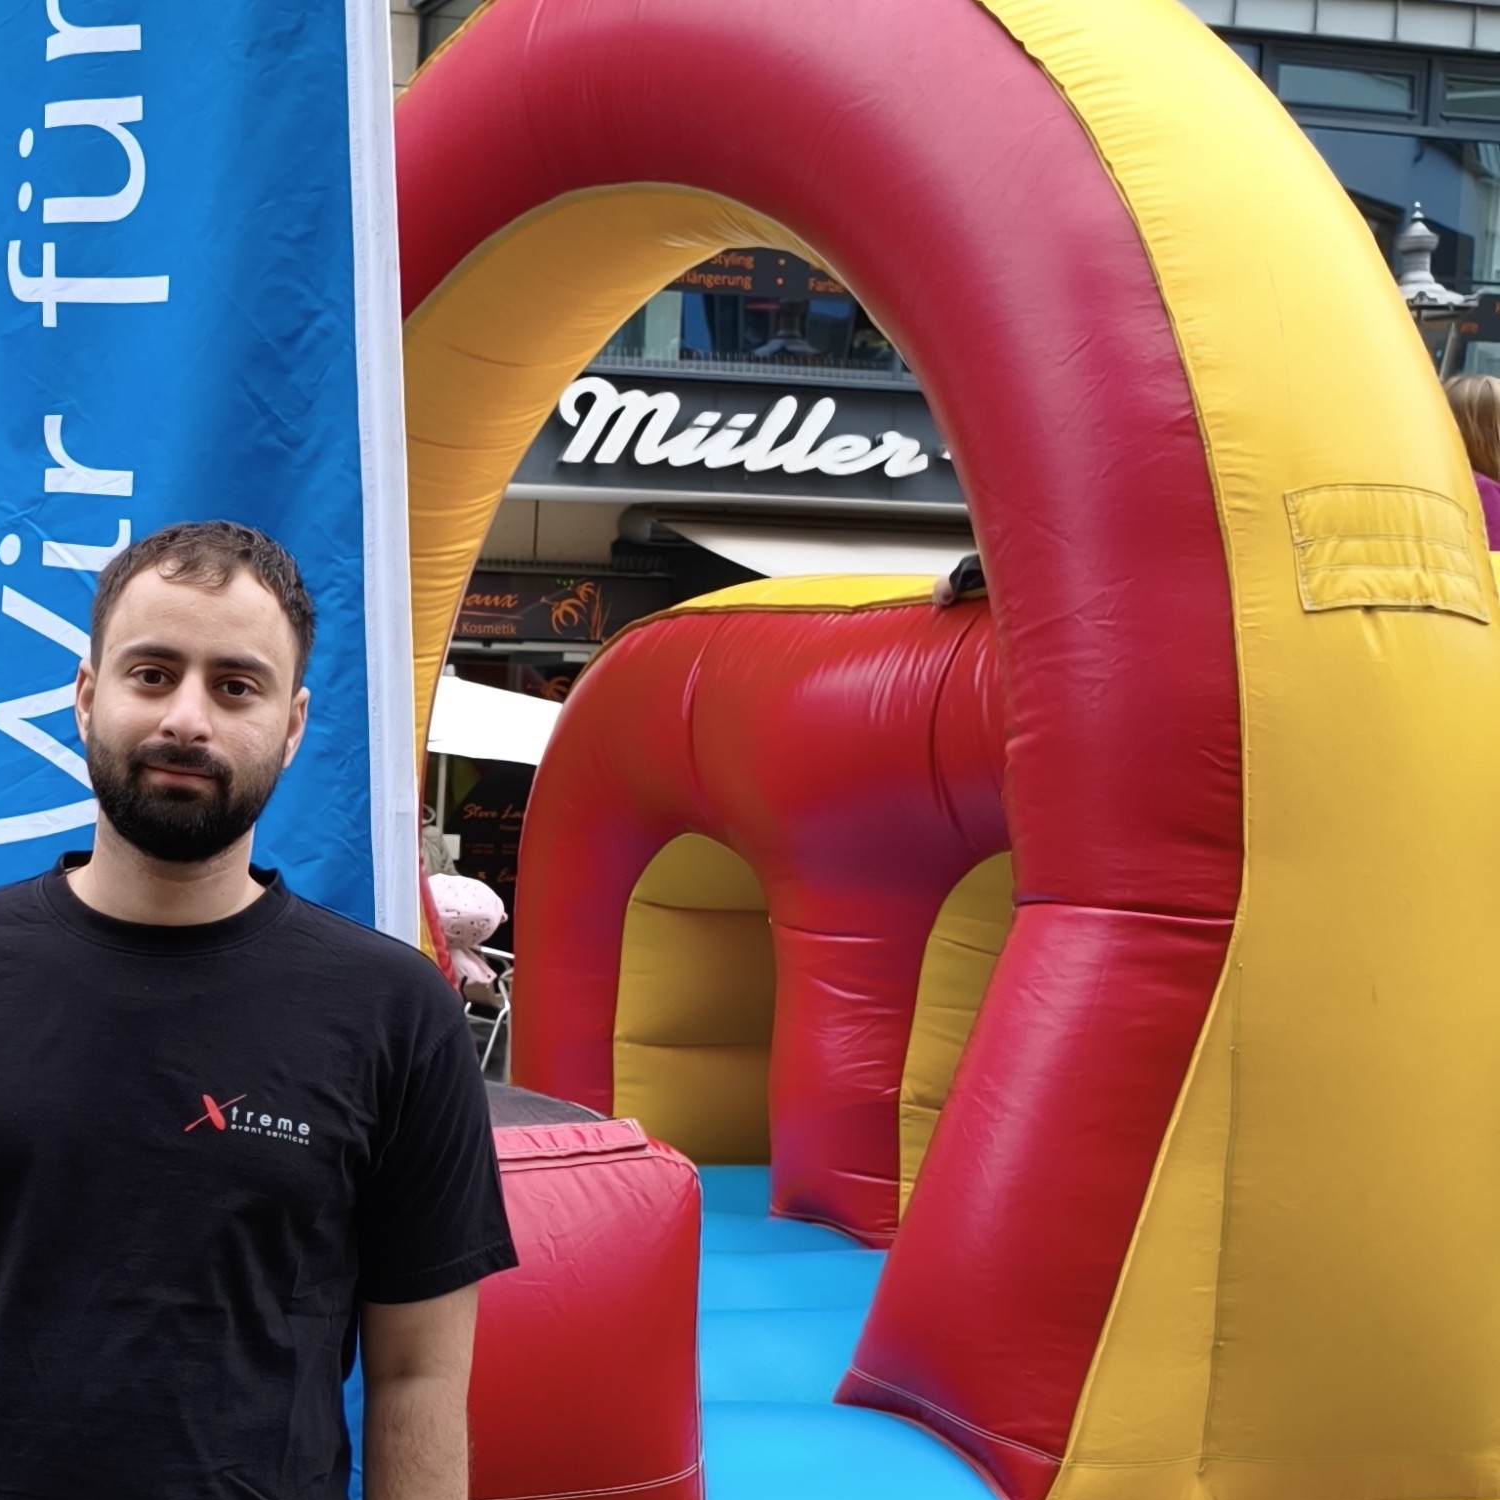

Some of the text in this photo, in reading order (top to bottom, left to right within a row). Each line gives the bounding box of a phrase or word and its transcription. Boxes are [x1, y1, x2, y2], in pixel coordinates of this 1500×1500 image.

[7, 0, 170, 328] für
[558, 376, 929, 478] Müller
[461, 621, 517, 635] Kosmetik
[184, 1094, 311, 1136] Xtreme
[230, 1123, 310, 1146] event services
